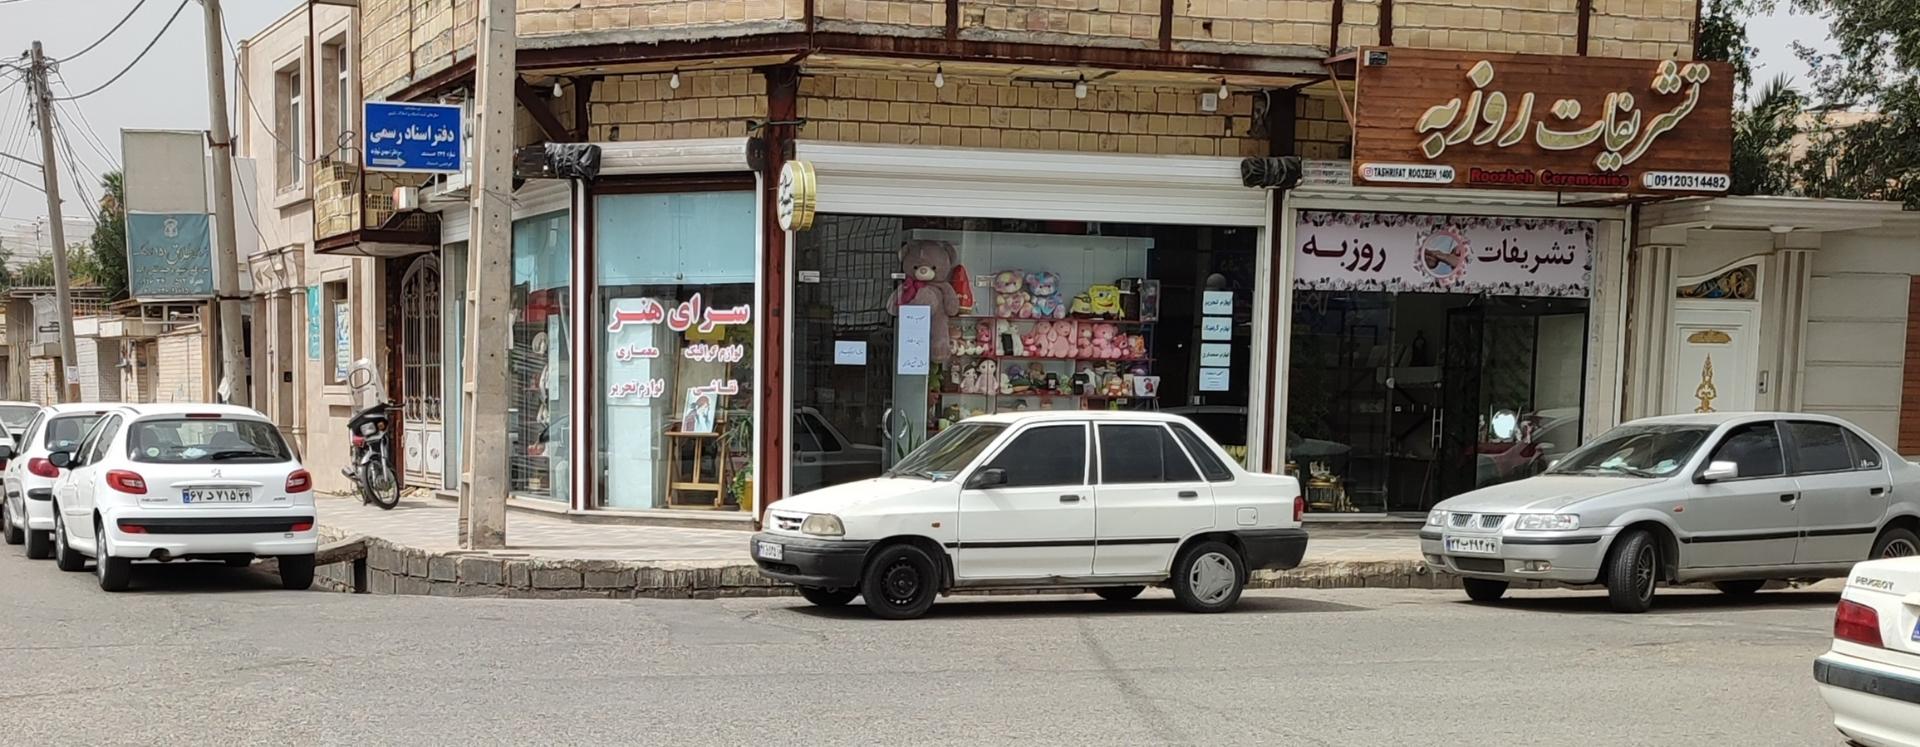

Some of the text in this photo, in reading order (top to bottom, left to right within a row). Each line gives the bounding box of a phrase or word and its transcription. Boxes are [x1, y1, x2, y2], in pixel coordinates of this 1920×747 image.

[1415, 60, 1710, 171] تشریفات روزبه
[369, 124, 455, 147] دفتر اسناد رسمی
[1470, 168, 1630, 187] Roozbeh Ceremonies
[1654, 174, 1726, 188] 09120314482
[1302, 234, 1576, 274] تشریفات روزبه
[608, 293, 750, 332] سرای هنر
[616, 344, 659, 361] معماری
[685, 344, 743, 362] لوازم گرافیک
[609, 378, 665, 398] لوازم تحریر
[693, 379, 739, 396] نقاشی
[1855, 576, 1894, 590] PEUGEOT
